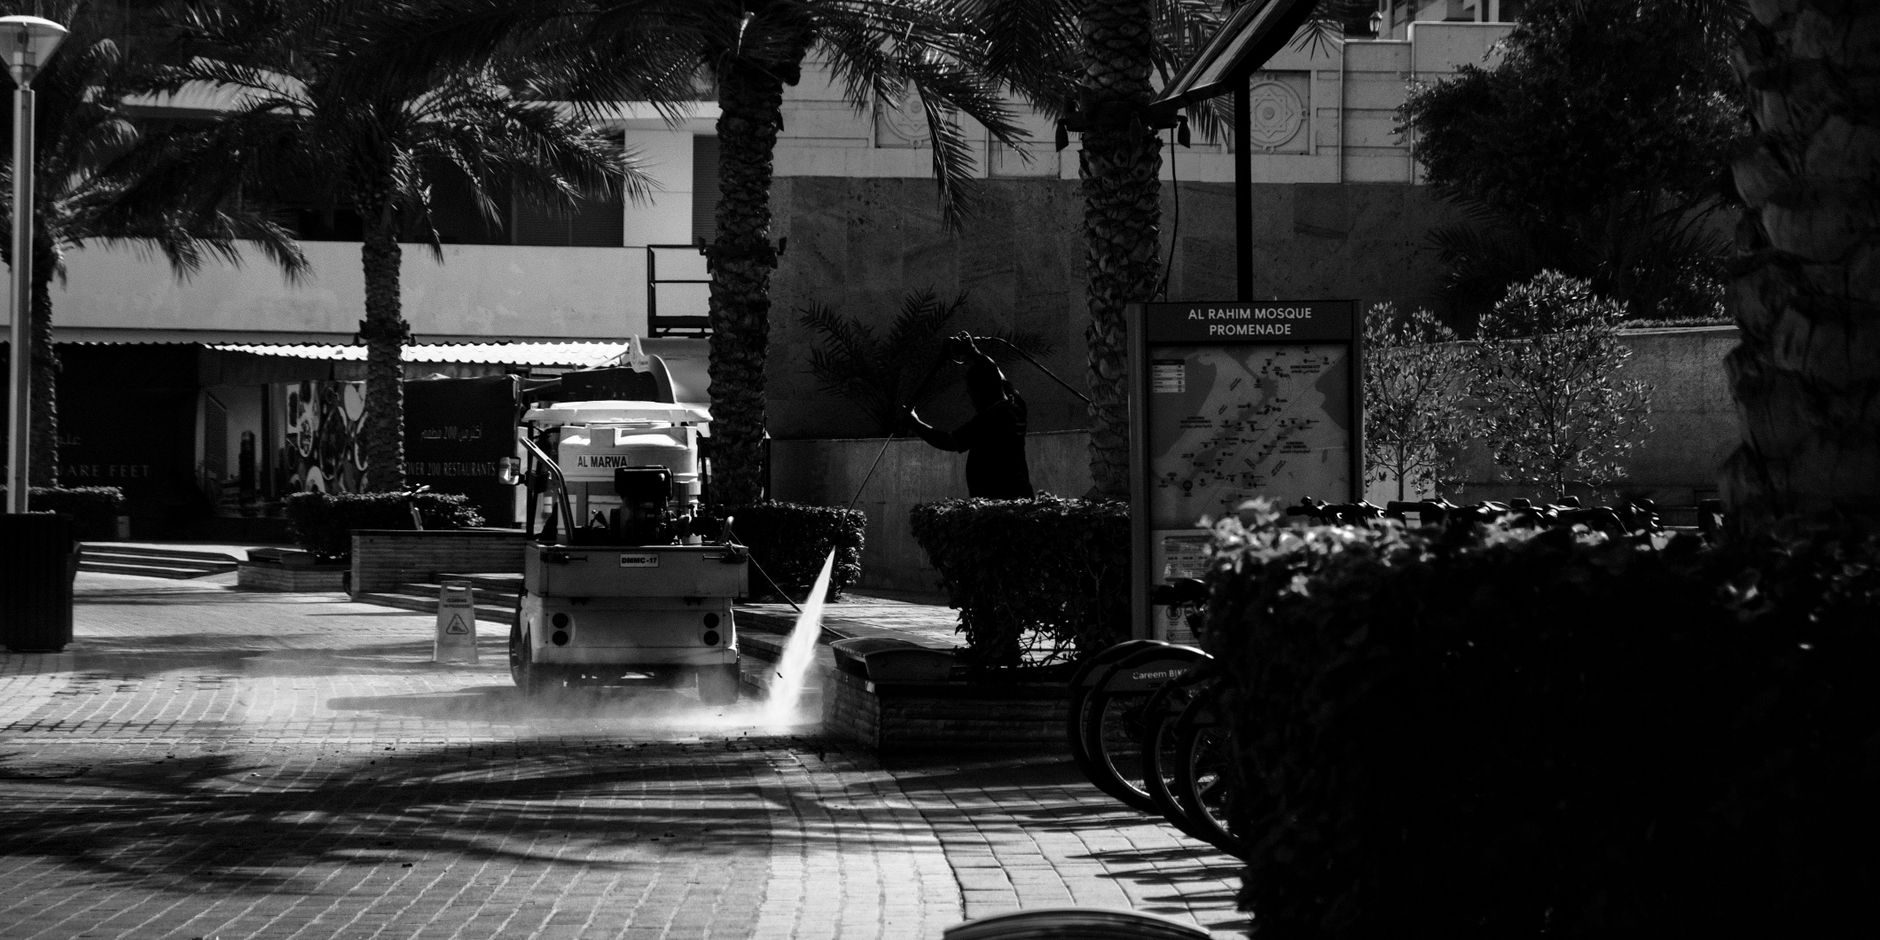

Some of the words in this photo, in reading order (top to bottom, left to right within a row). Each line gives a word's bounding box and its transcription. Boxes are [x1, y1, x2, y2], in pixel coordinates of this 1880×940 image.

[1188, 308, 1205, 320] AL
[1208, 308, 1251, 320] RAHIM
[1254, 307, 1312, 319] MOSQUE
[1209, 323, 1292, 336] PROMENADE
[577, 456, 588, 468] AL
[590, 455, 628, 468] MARWA
[109, 464, 150, 479] FEET
[443, 461, 496, 477] RESTAURANTS
[1132, 671, 1167, 680] Careem
